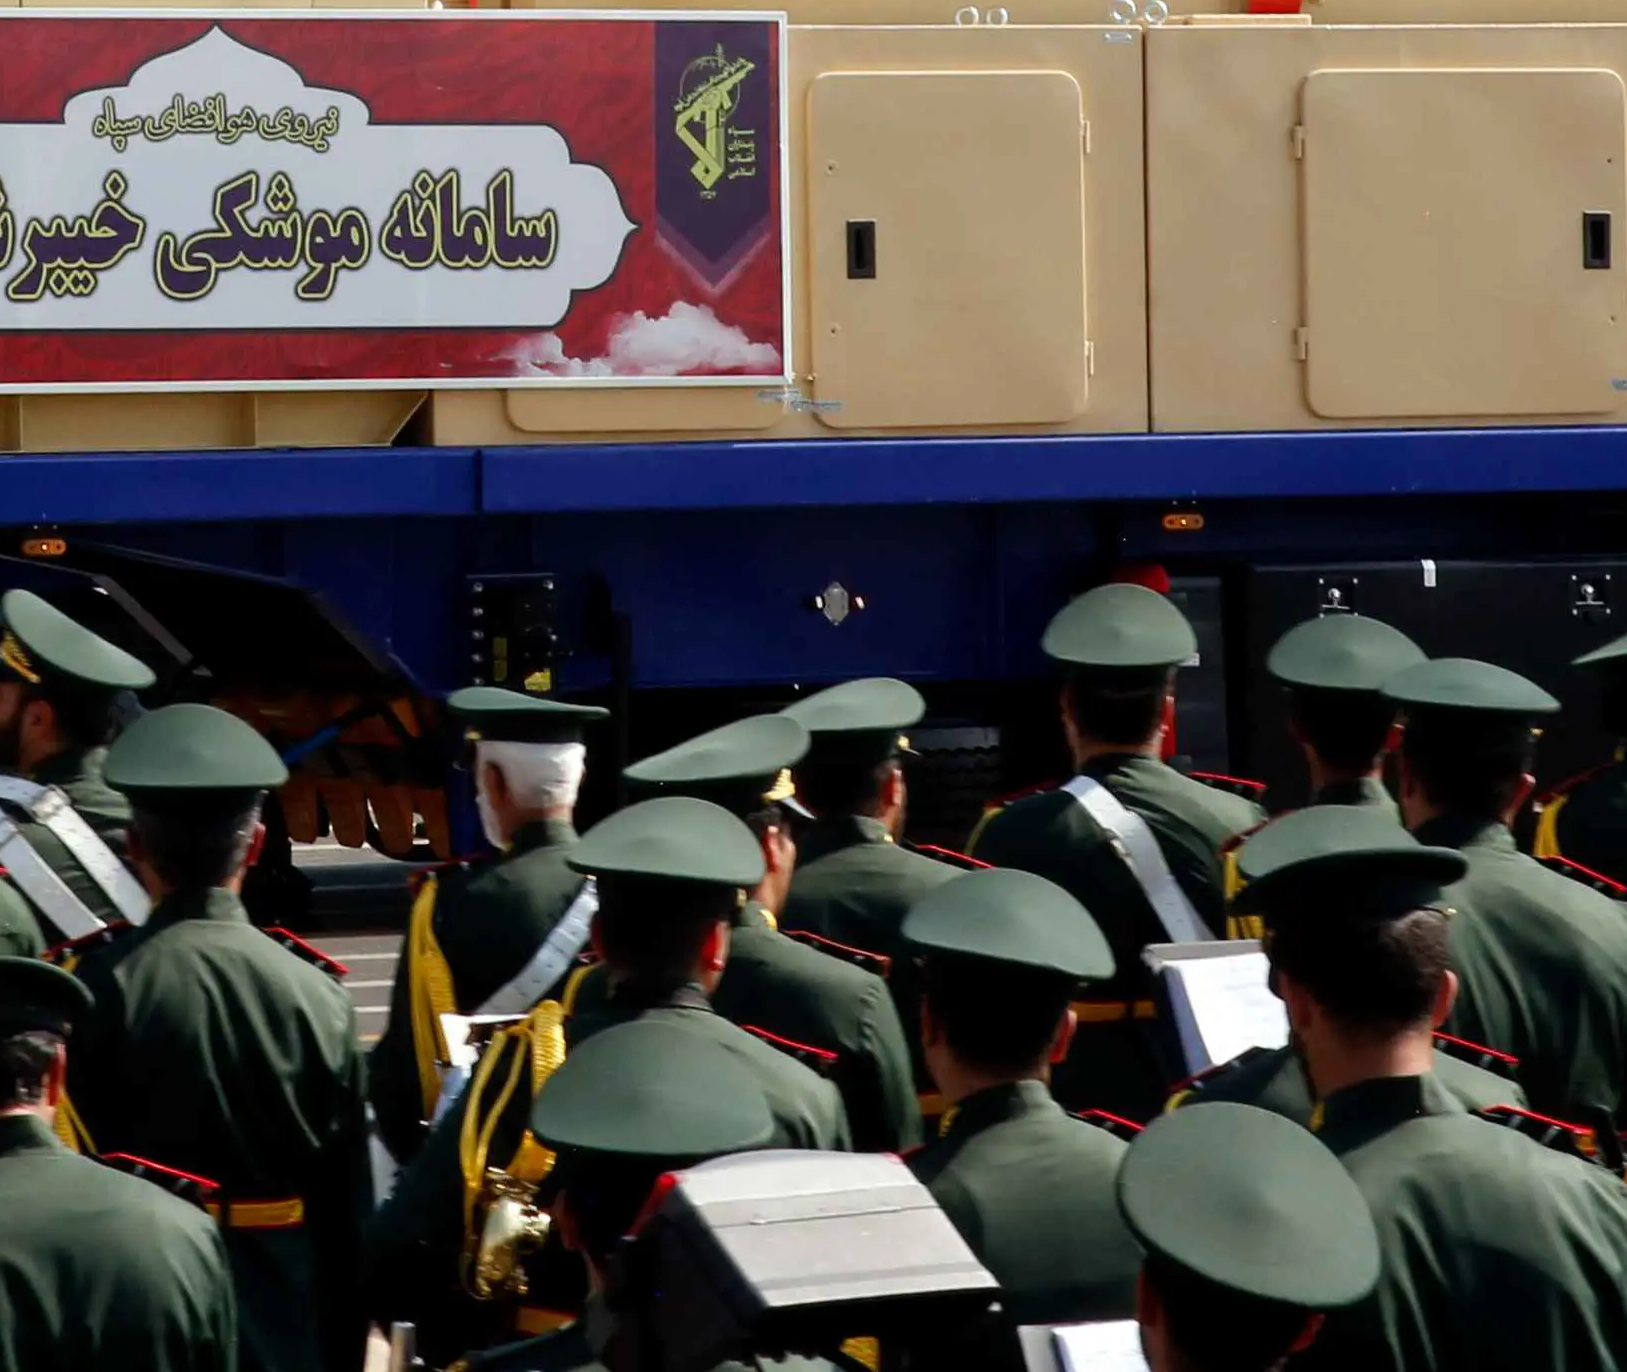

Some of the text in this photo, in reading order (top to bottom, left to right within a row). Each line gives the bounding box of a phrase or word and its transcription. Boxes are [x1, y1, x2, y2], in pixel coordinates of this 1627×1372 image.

[92, 92, 340, 153] نیروی هوافضای سپاه
[153, 169, 371, 302] موشکی
[378, 167, 561, 271] سامانه
